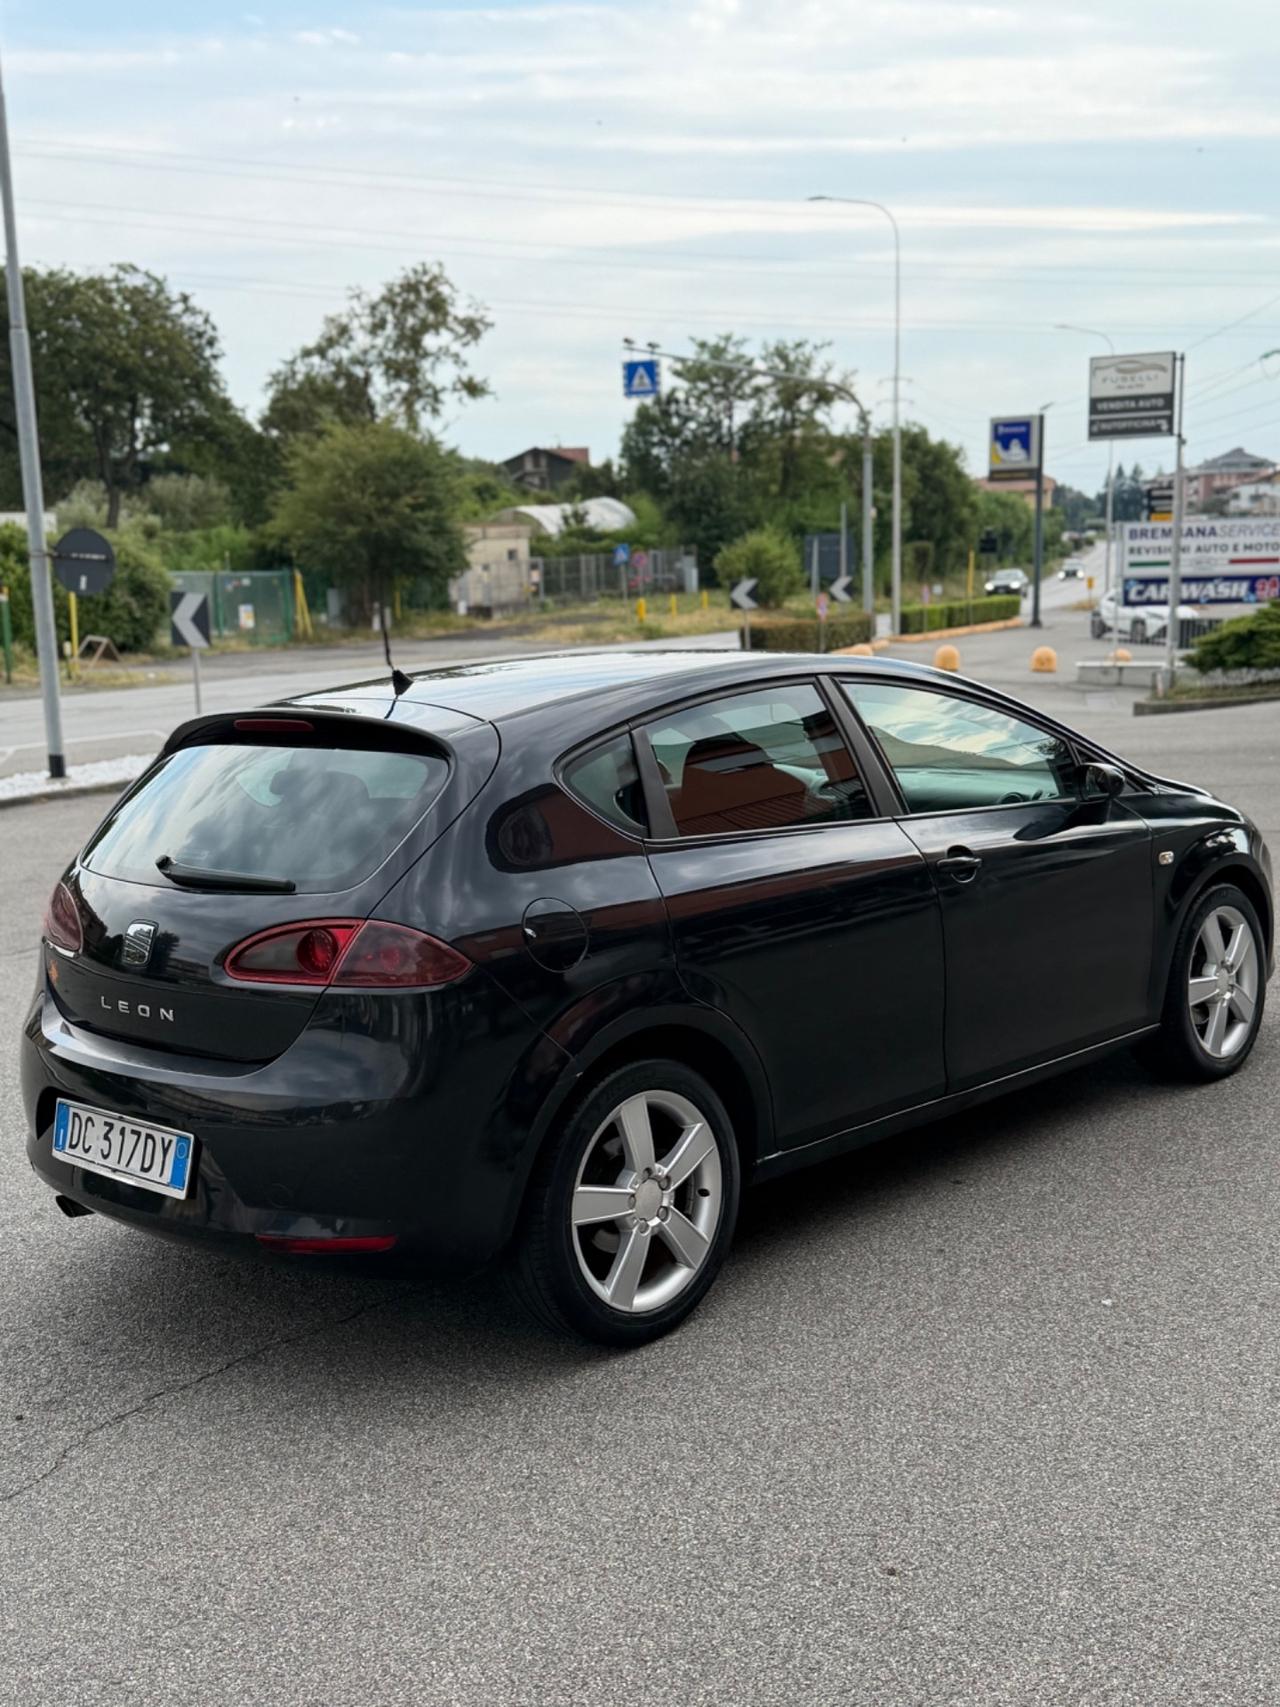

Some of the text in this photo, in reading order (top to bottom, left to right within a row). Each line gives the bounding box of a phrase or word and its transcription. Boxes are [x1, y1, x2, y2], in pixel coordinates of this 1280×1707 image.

[1138, 398, 1165, 407] AUTO
[1195, 543, 1229, 553] AUTO
[1233, 543, 1239, 552] E
[1243, 542, 1280, 552] MOTO
[1180, 580, 1250, 600] WASH
[100, 995, 175, 1022] LEON
